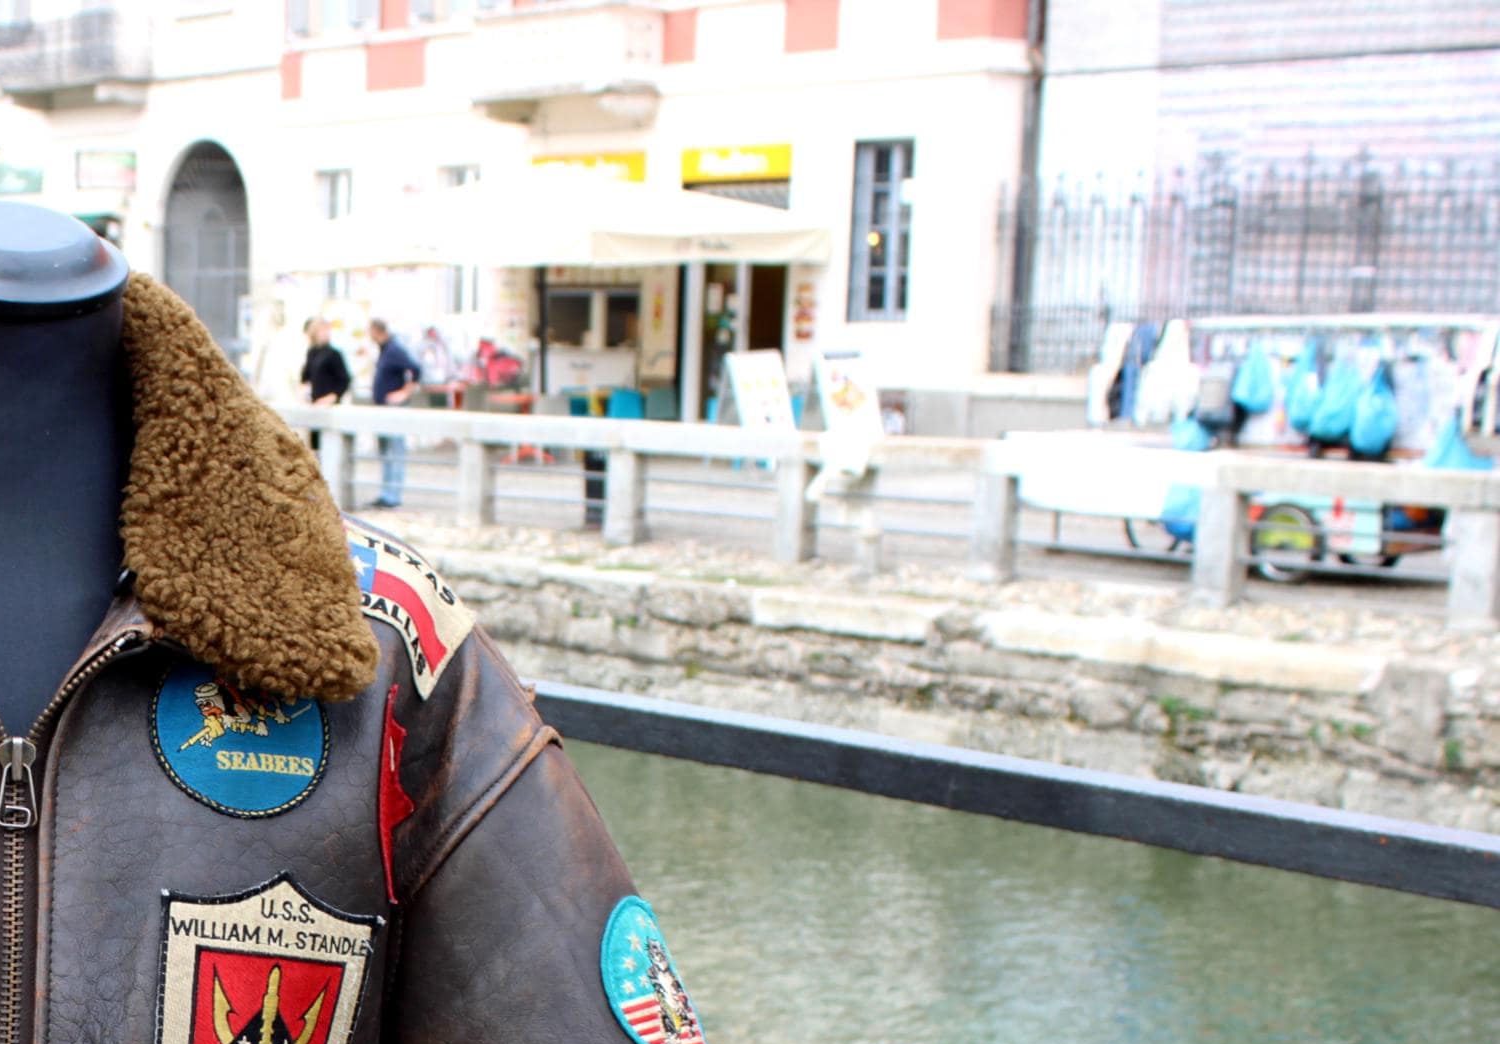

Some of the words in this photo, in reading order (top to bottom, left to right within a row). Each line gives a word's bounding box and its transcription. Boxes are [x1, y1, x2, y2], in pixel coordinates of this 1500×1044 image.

[364, 536, 456, 607] TEXAS
[360, 593, 426, 677] DALLAS
[216, 750, 316, 776] SEABEES
[260, 897, 316, 924] U.S.S.
[170, 916, 260, 944] WILLIAM
[267, 930, 290, 948] M.
